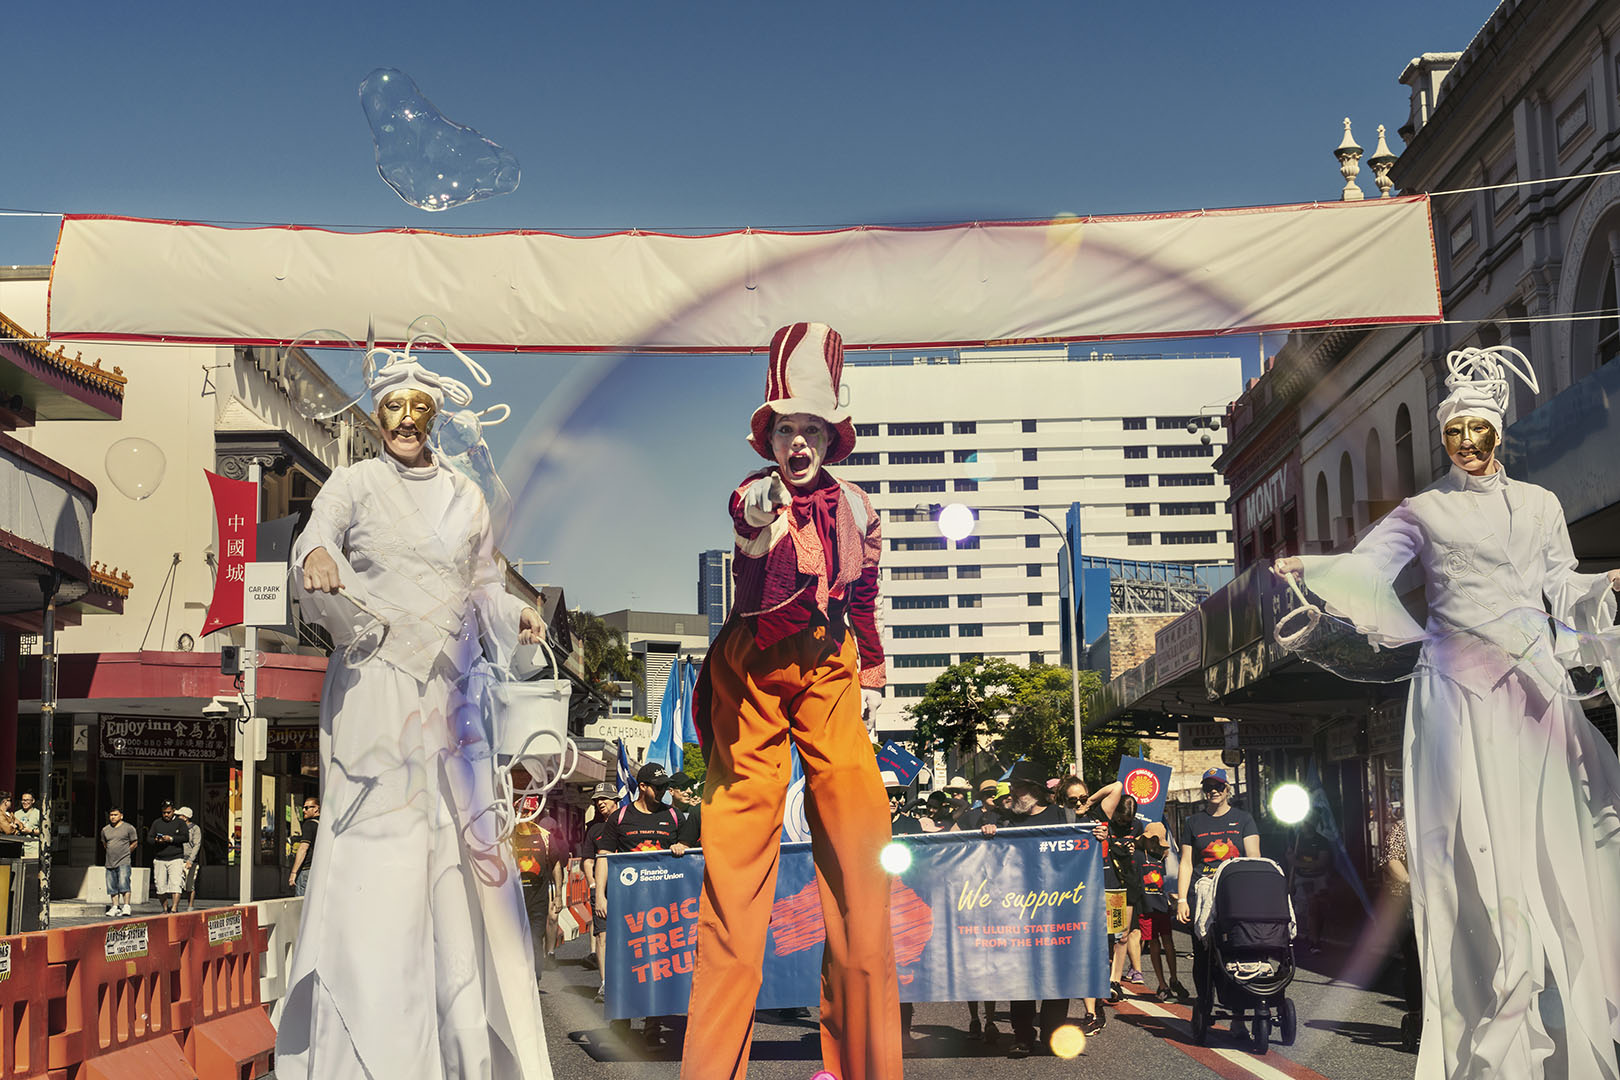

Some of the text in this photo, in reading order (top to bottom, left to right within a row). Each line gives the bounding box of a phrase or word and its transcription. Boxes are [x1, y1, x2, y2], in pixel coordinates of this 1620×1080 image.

[1246, 463, 1287, 529] MONTY
[226, 513, 244, 582] 中國城
[599, 725, 646, 739] CATHEDRAL
[114, 746, 176, 757] RESTAURANT
[1039, 839, 1090, 852] #YES23
[624, 897, 699, 933] VOIC
[958, 879, 992, 911] We
[1001, 882, 1086, 920] support
[628, 923, 698, 959] TREA
[957, 922, 1088, 935] THE ULURU STATEMENT
[975, 936, 1072, 947] FROM THE HEART
[632, 950, 696, 984] TRU
